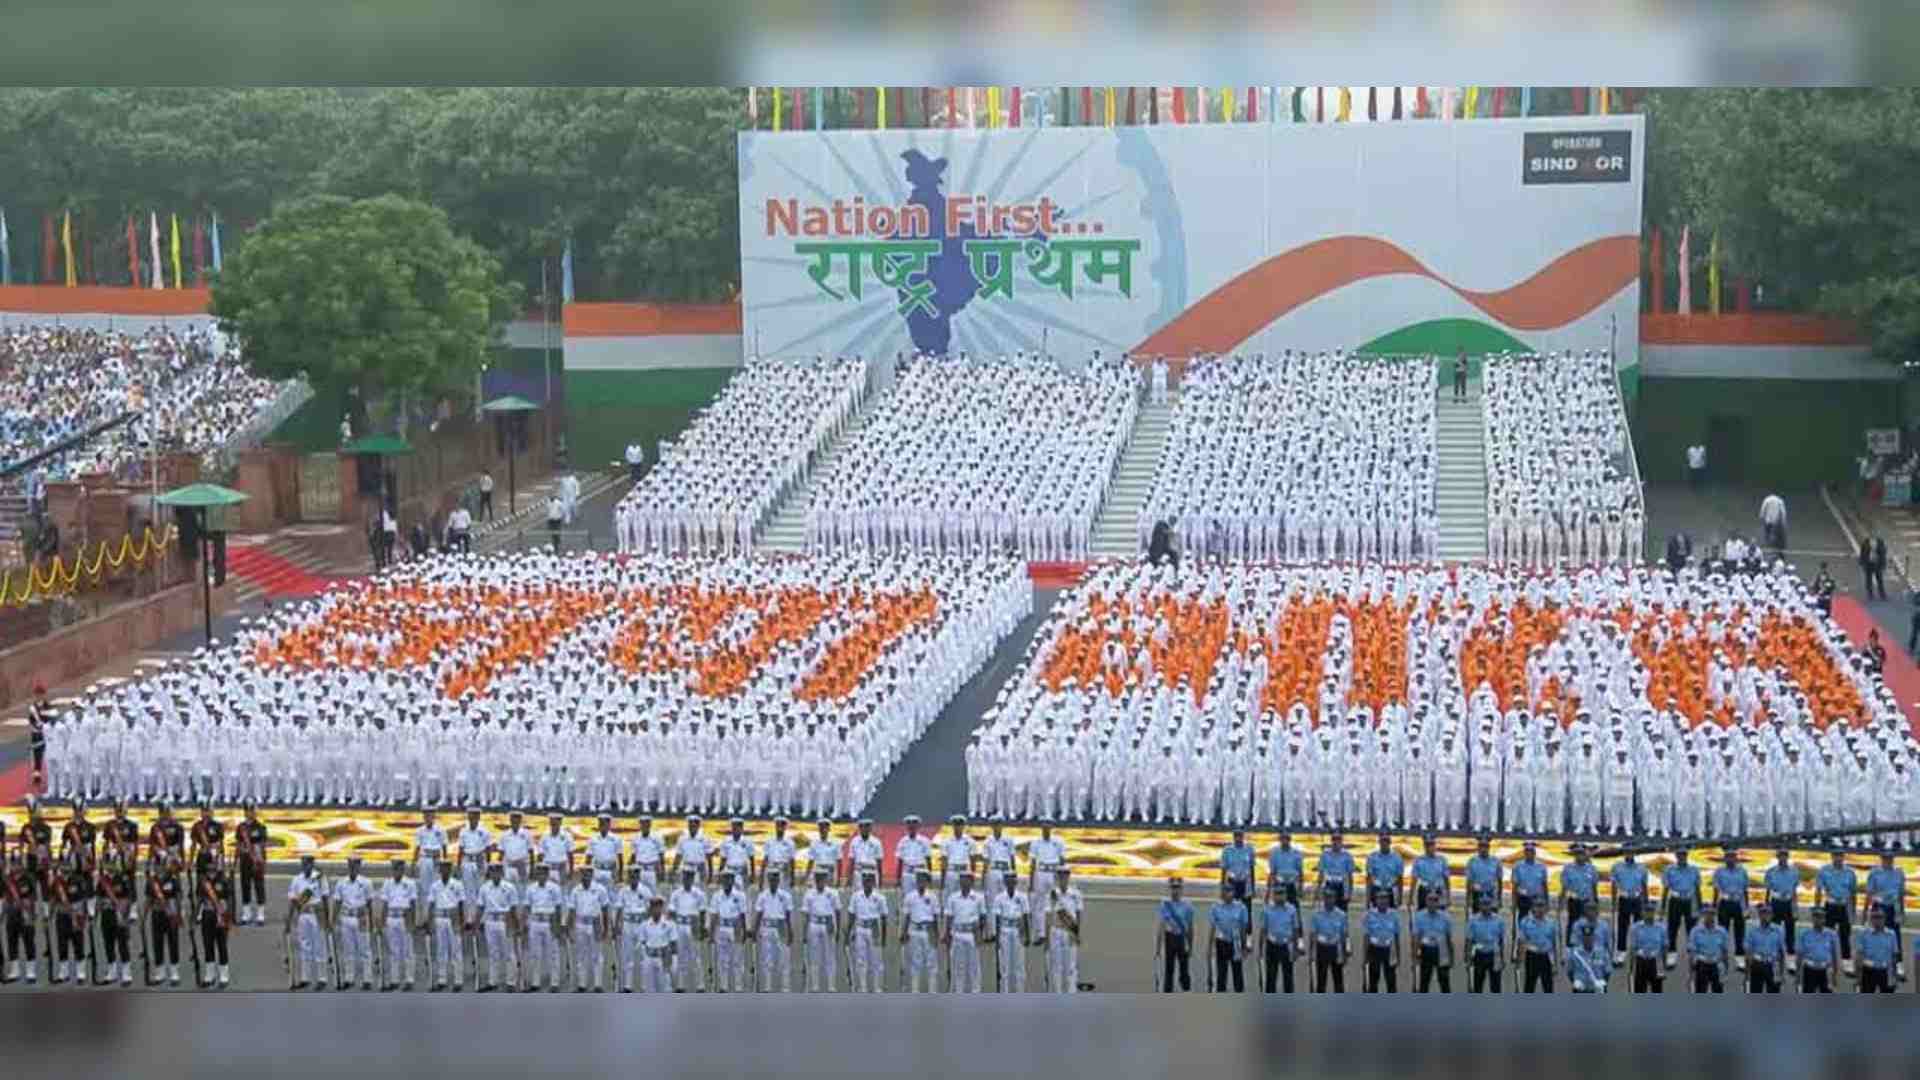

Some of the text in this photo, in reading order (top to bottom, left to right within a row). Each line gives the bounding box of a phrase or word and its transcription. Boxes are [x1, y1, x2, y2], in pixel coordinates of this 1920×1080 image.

[1530, 156, 1624, 172] SINDOR
[765, 196, 1105, 238] Nation First...
[794, 239, 1141, 318] राष्ट्र प्रथम
